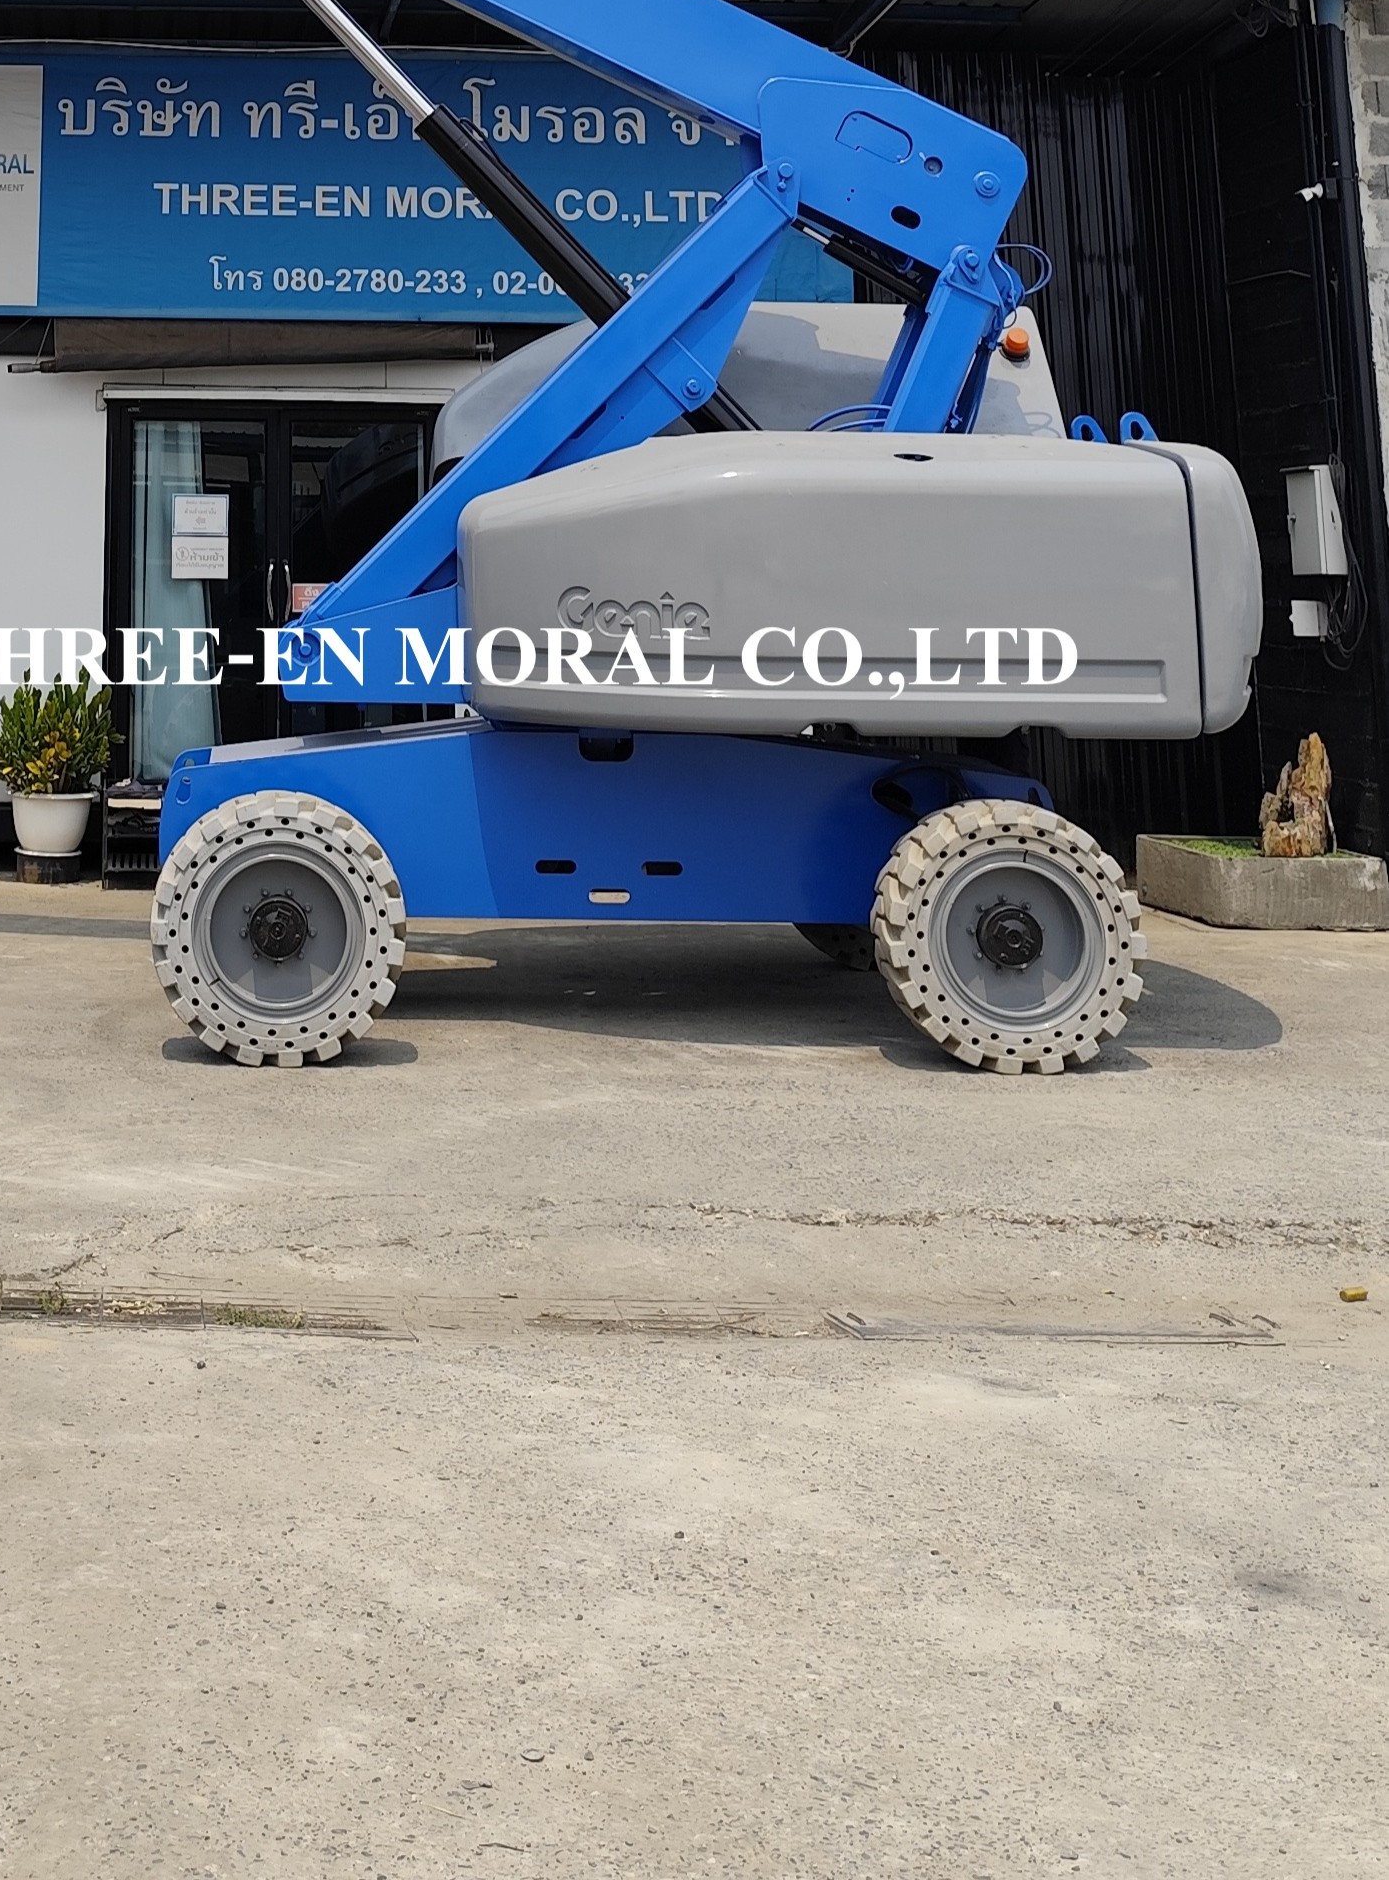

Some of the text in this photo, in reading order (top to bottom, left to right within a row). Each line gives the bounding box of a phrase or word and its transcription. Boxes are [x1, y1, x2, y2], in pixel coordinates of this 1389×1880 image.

[58, 76, 221, 138] บริษัท
[462, 77, 646, 145] โมรอล
[153, 182, 371, 218] THREE-EN
[386, 186, 494, 219] MOR
[208, 255, 264, 291] โทร
[273, 267, 467, 294] 080-2780-233
[557, 586, 711, 640] Genie
